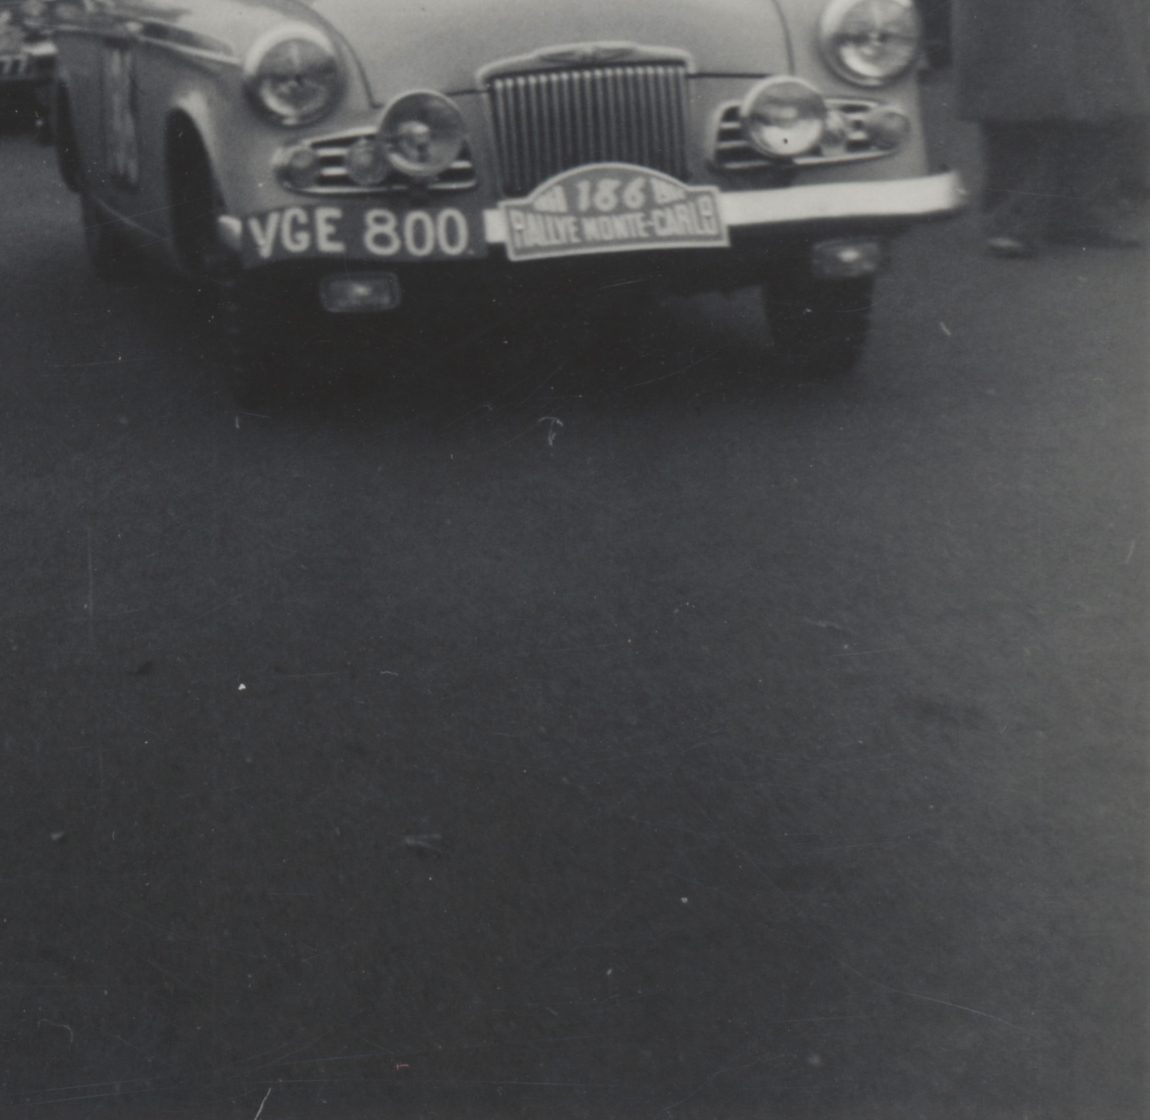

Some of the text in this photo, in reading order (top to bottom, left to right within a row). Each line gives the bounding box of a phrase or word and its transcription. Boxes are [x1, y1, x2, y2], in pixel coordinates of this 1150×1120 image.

[250, 206, 469, 259] VGE 800
[509, 209, 581, 248] RALLYE
[582, 194, 720, 242] MONTE-CARLO
